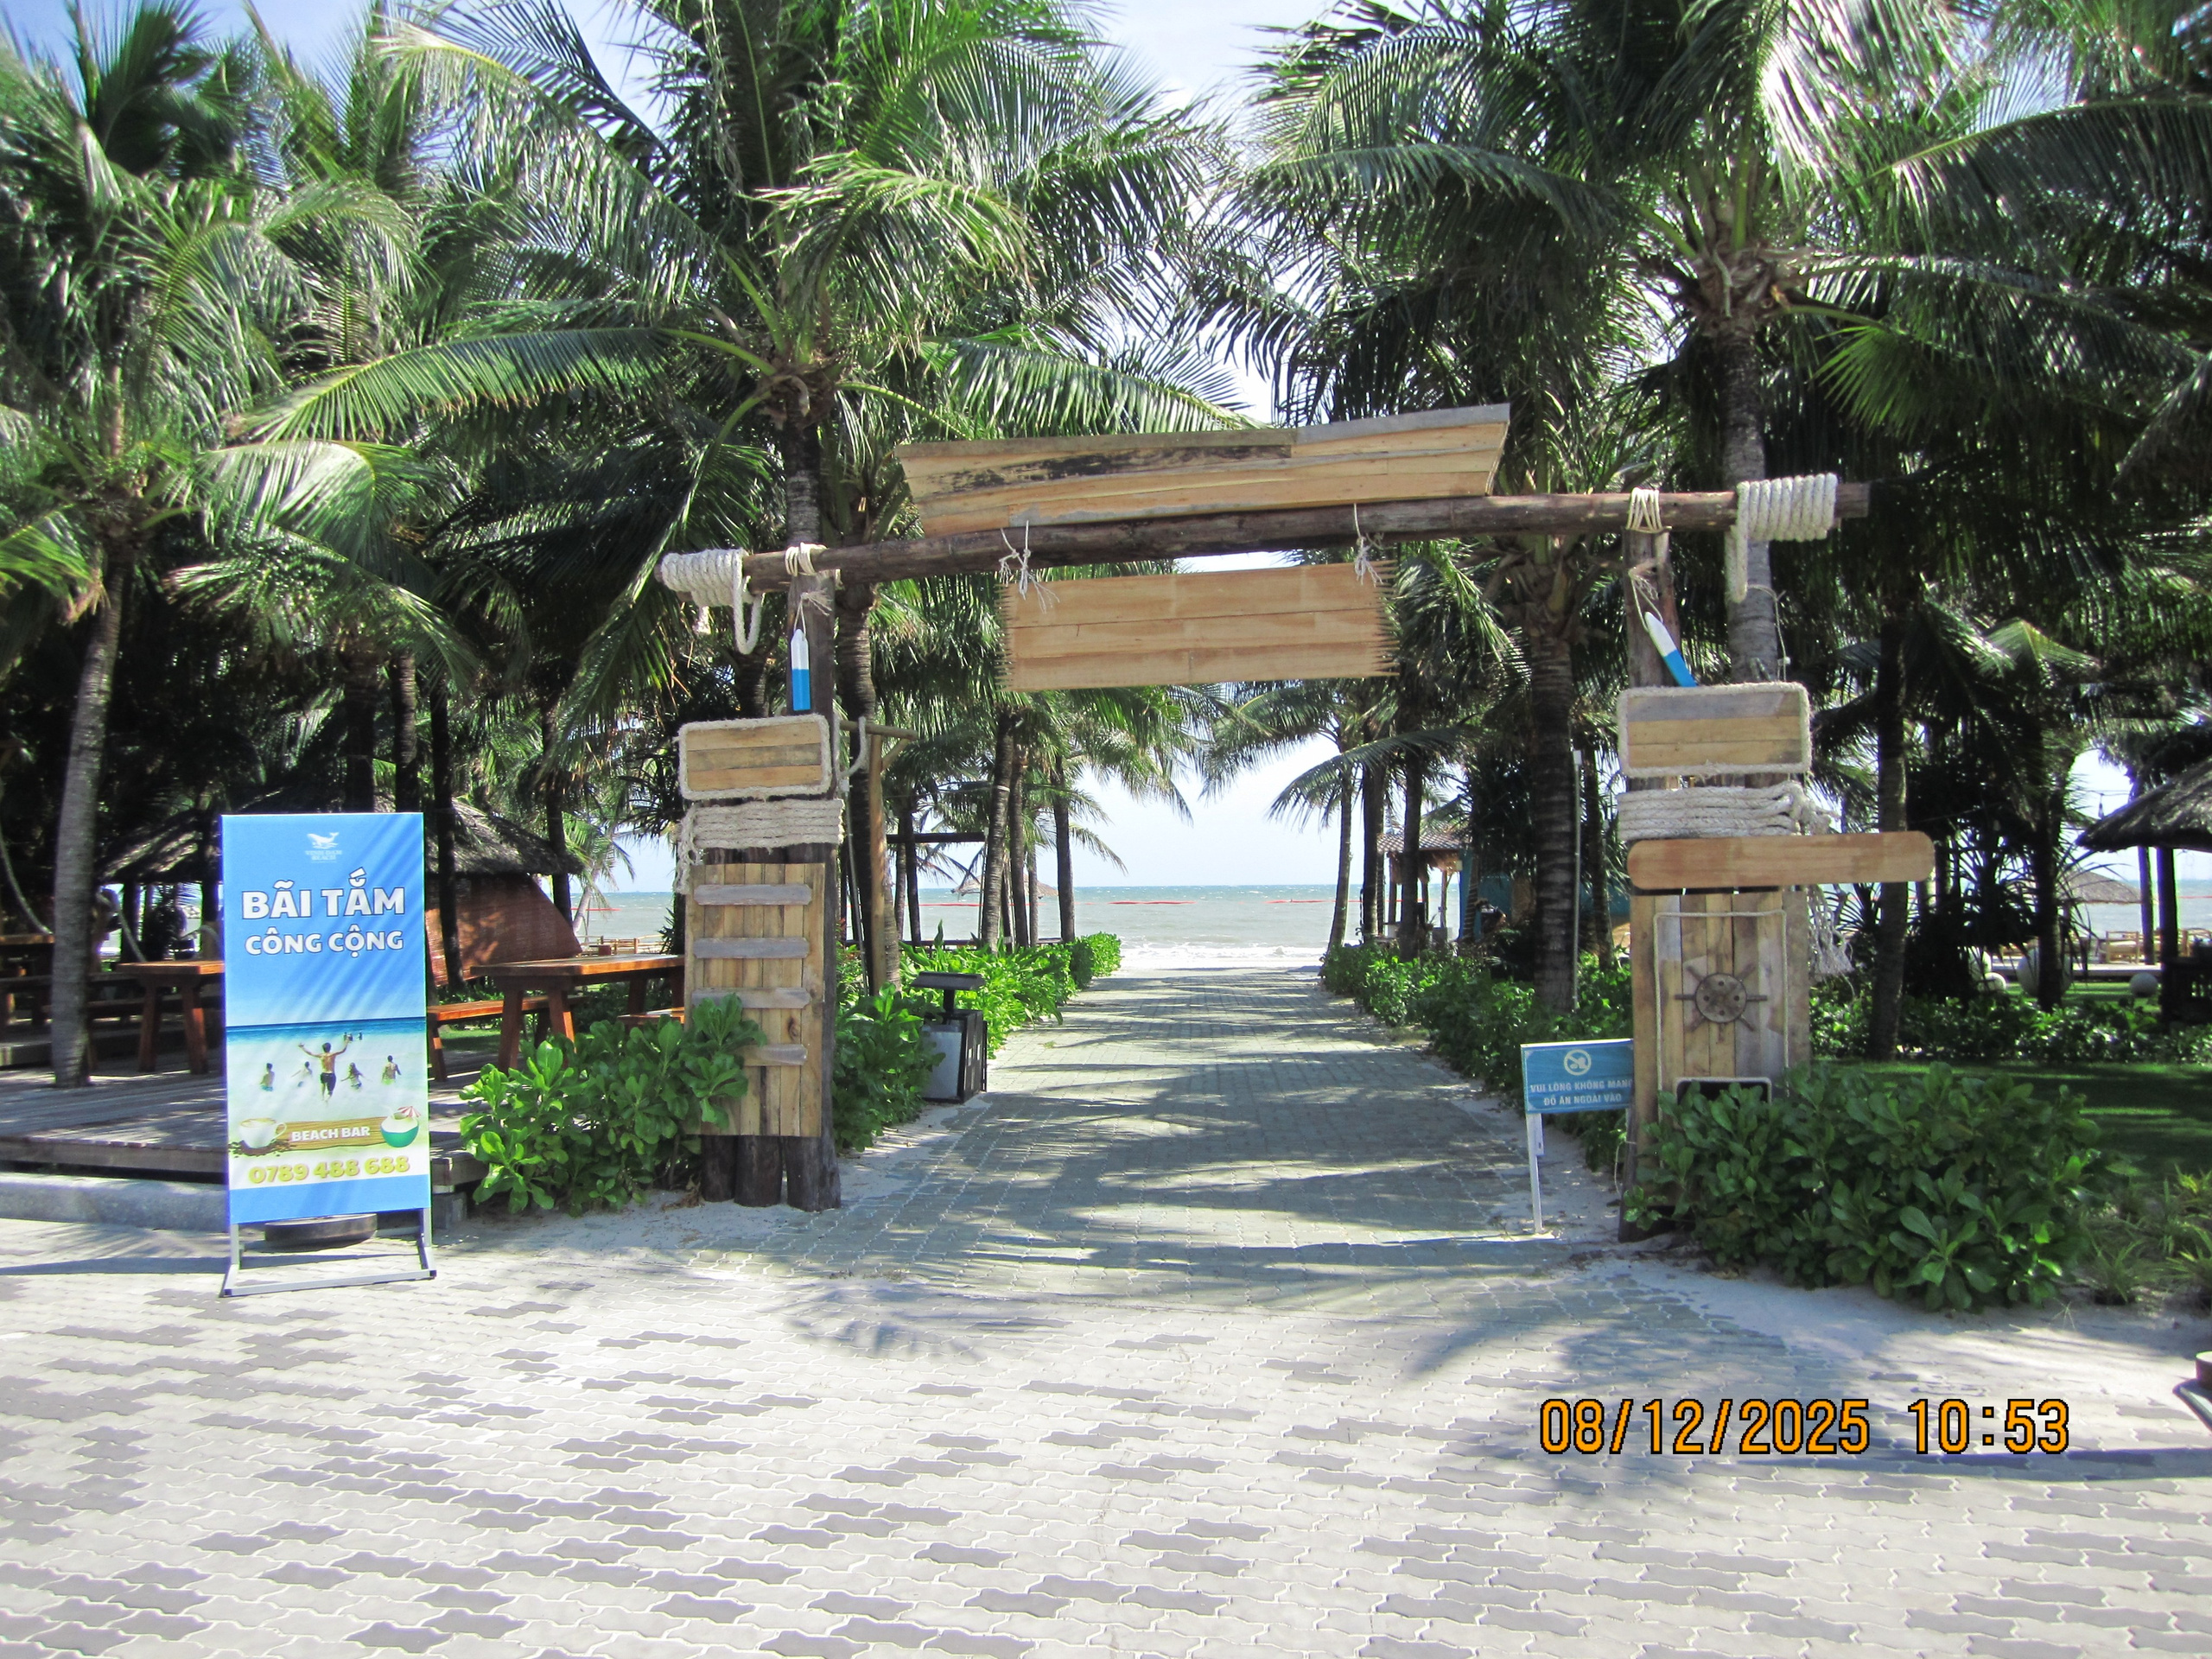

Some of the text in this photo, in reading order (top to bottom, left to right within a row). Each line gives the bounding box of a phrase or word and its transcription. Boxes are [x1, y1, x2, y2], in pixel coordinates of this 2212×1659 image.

[242, 867, 405, 919] BÃI TẮM
[245, 924, 404, 958] CÔNG CỘNG
[1530, 1084, 1546, 1093] VUI
[1574, 1079, 1605, 1090] KHÔNG
[1573, 1093, 1601, 1104] NGOÀI
[1604, 1091, 1622, 1103] VÀO
[291, 1126, 371, 1142] BEACH BAR
[248, 1155, 410, 1184] 0789 488 688
